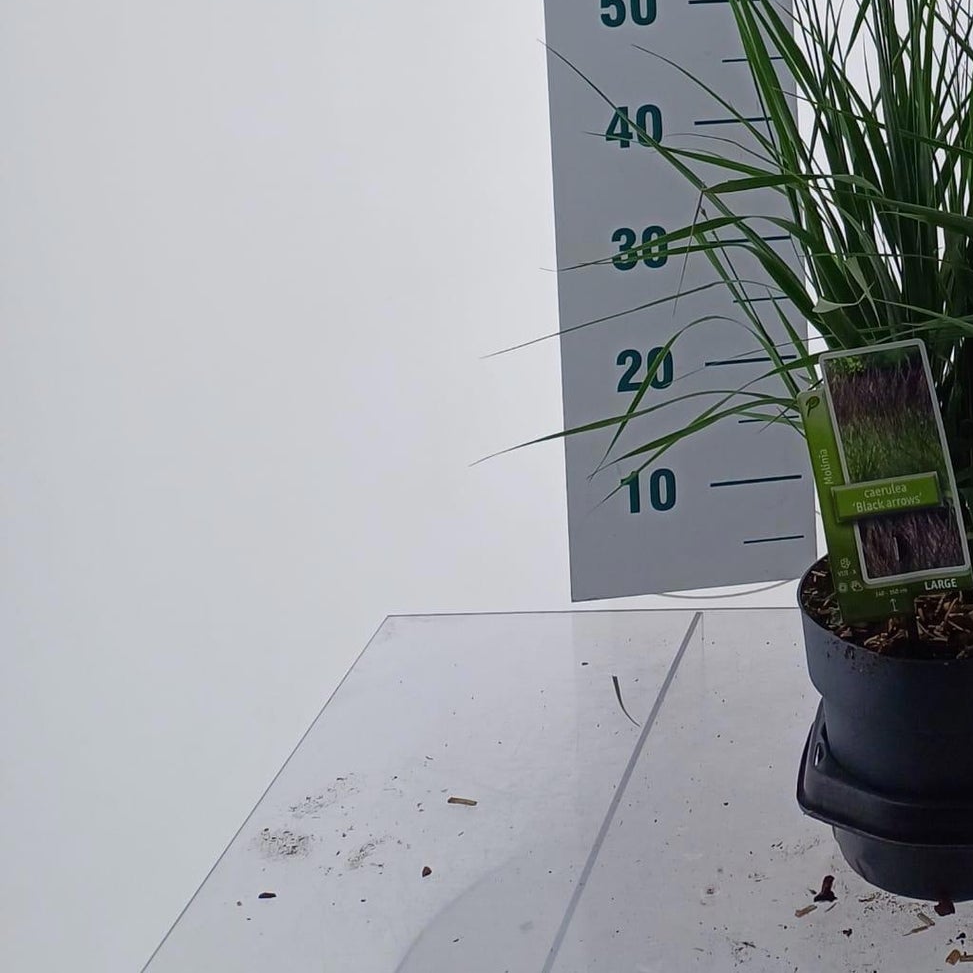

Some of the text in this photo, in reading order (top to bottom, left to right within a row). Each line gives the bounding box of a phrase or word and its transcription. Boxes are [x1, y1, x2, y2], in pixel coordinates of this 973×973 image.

[605, 104, 663, 149] 40
[611, 225, 668, 271] 30
[616, 346, 674, 393] 20
[819, 449, 833, 485] Molinia
[621, 467, 677, 514] 10
[852, 492, 923, 514] 'Black arrows'
[863, 483, 908, 498] caerulea
[925, 578, 958, 591] LARGE
